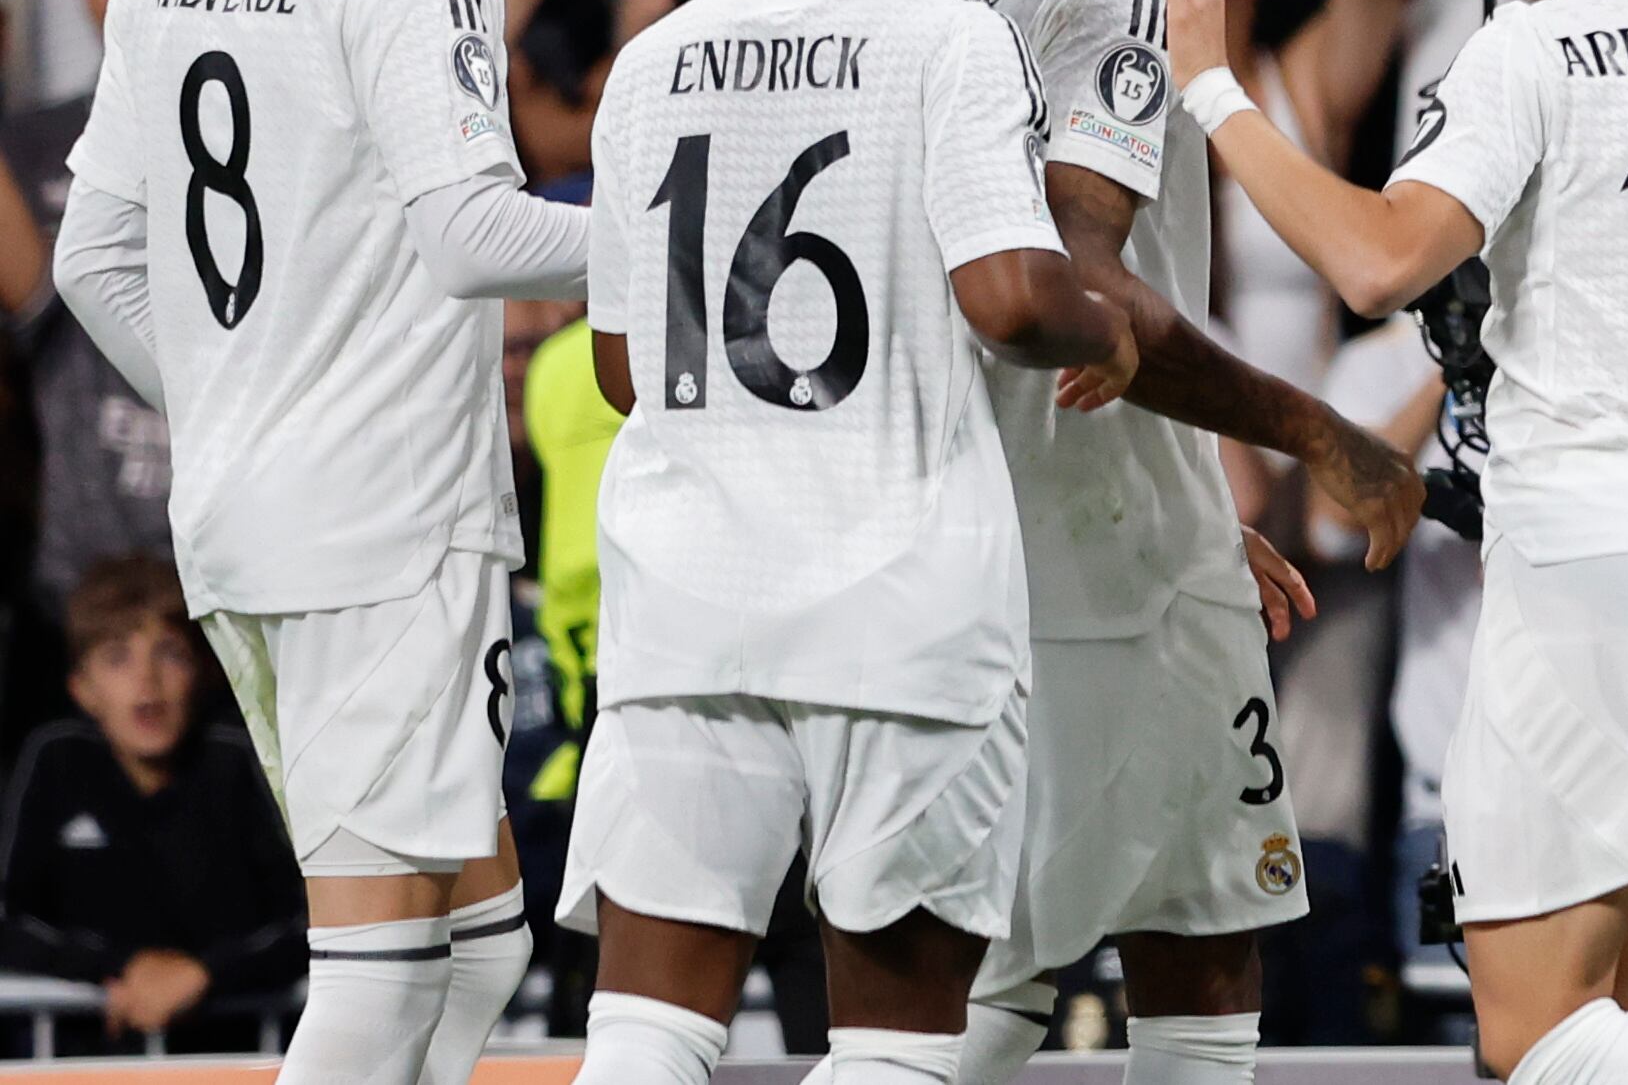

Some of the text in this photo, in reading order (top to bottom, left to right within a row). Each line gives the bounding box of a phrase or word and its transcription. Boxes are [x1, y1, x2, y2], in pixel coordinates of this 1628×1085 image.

[669, 33, 869, 95] ENDRICK
[1120, 79, 1143, 101] 15
[1070, 117, 1160, 161] FOUNDATION
[179, 50, 264, 330] 8
[645, 129, 870, 412] 16
[1232, 697, 1284, 806] 3
